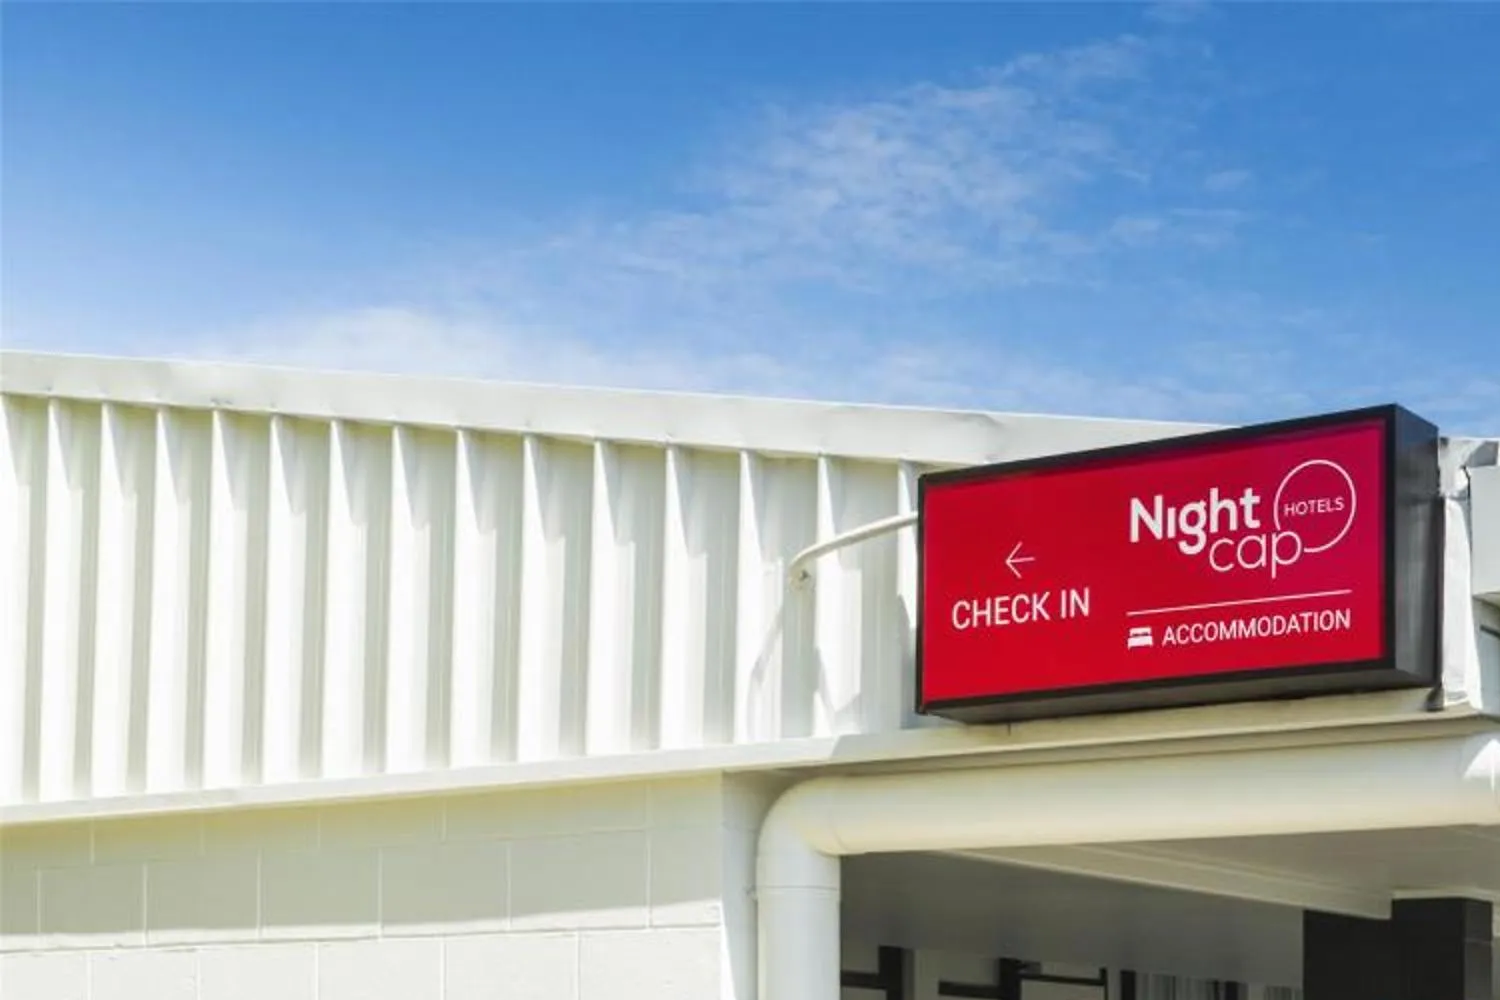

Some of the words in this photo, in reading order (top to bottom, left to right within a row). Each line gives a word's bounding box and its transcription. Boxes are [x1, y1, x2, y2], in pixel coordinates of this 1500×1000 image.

[1130, 488, 1260, 555] Night
[1284, 497, 1344, 517] HOTELS
[1209, 530, 1302, 579] cap
[952, 592, 1050, 629] CHECK
[1060, 587, 1090, 619] IN
[1162, 609, 1351, 647] ACCOMMODATION
